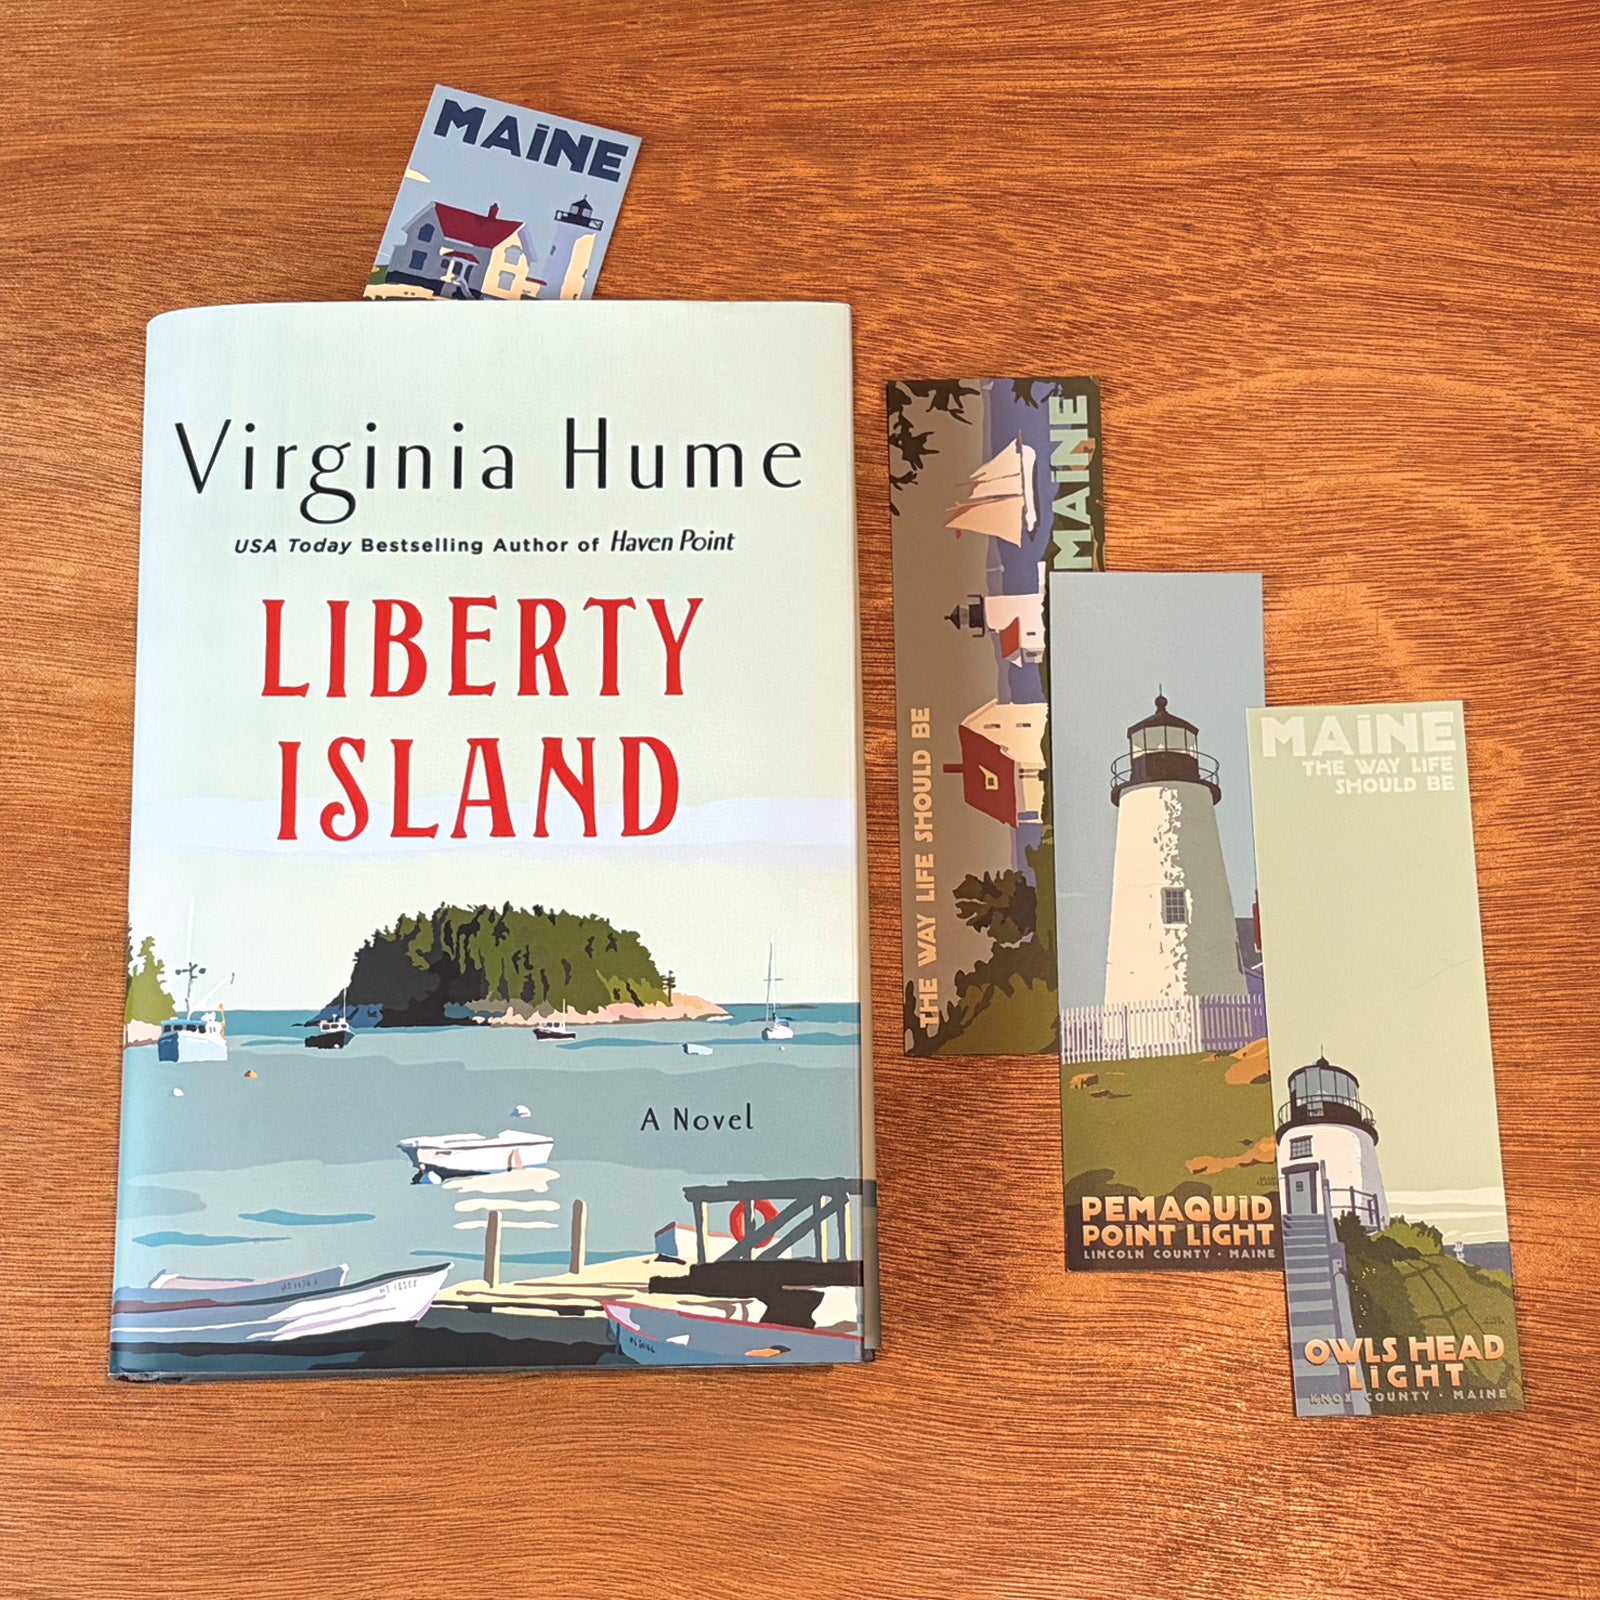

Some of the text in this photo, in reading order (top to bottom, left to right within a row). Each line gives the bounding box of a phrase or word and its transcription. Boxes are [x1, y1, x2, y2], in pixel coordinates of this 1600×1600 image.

[175, 417, 801, 524] Virginia Hume
[234, 529, 735, 554] USA Today Bestselling Author of Haven Point
[260, 595, 704, 698] LIBERTY
[1302, 756, 1454, 776] THE WAY LIFE
[277, 736, 679, 841] ISLAND
[1335, 775, 1455, 794] SHOULD BE
[910, 707, 939, 1029] THE WAY LIFE SHOULD BE
[640, 1102, 753, 1131] A Novel
[1083, 1248, 1276, 1260] LINCOLN COUNTY MAINE
[1304, 1334, 1505, 1364] OWLS HEAD
[1309, 1388, 1508, 1405] KNOX COUNTY MAINE
